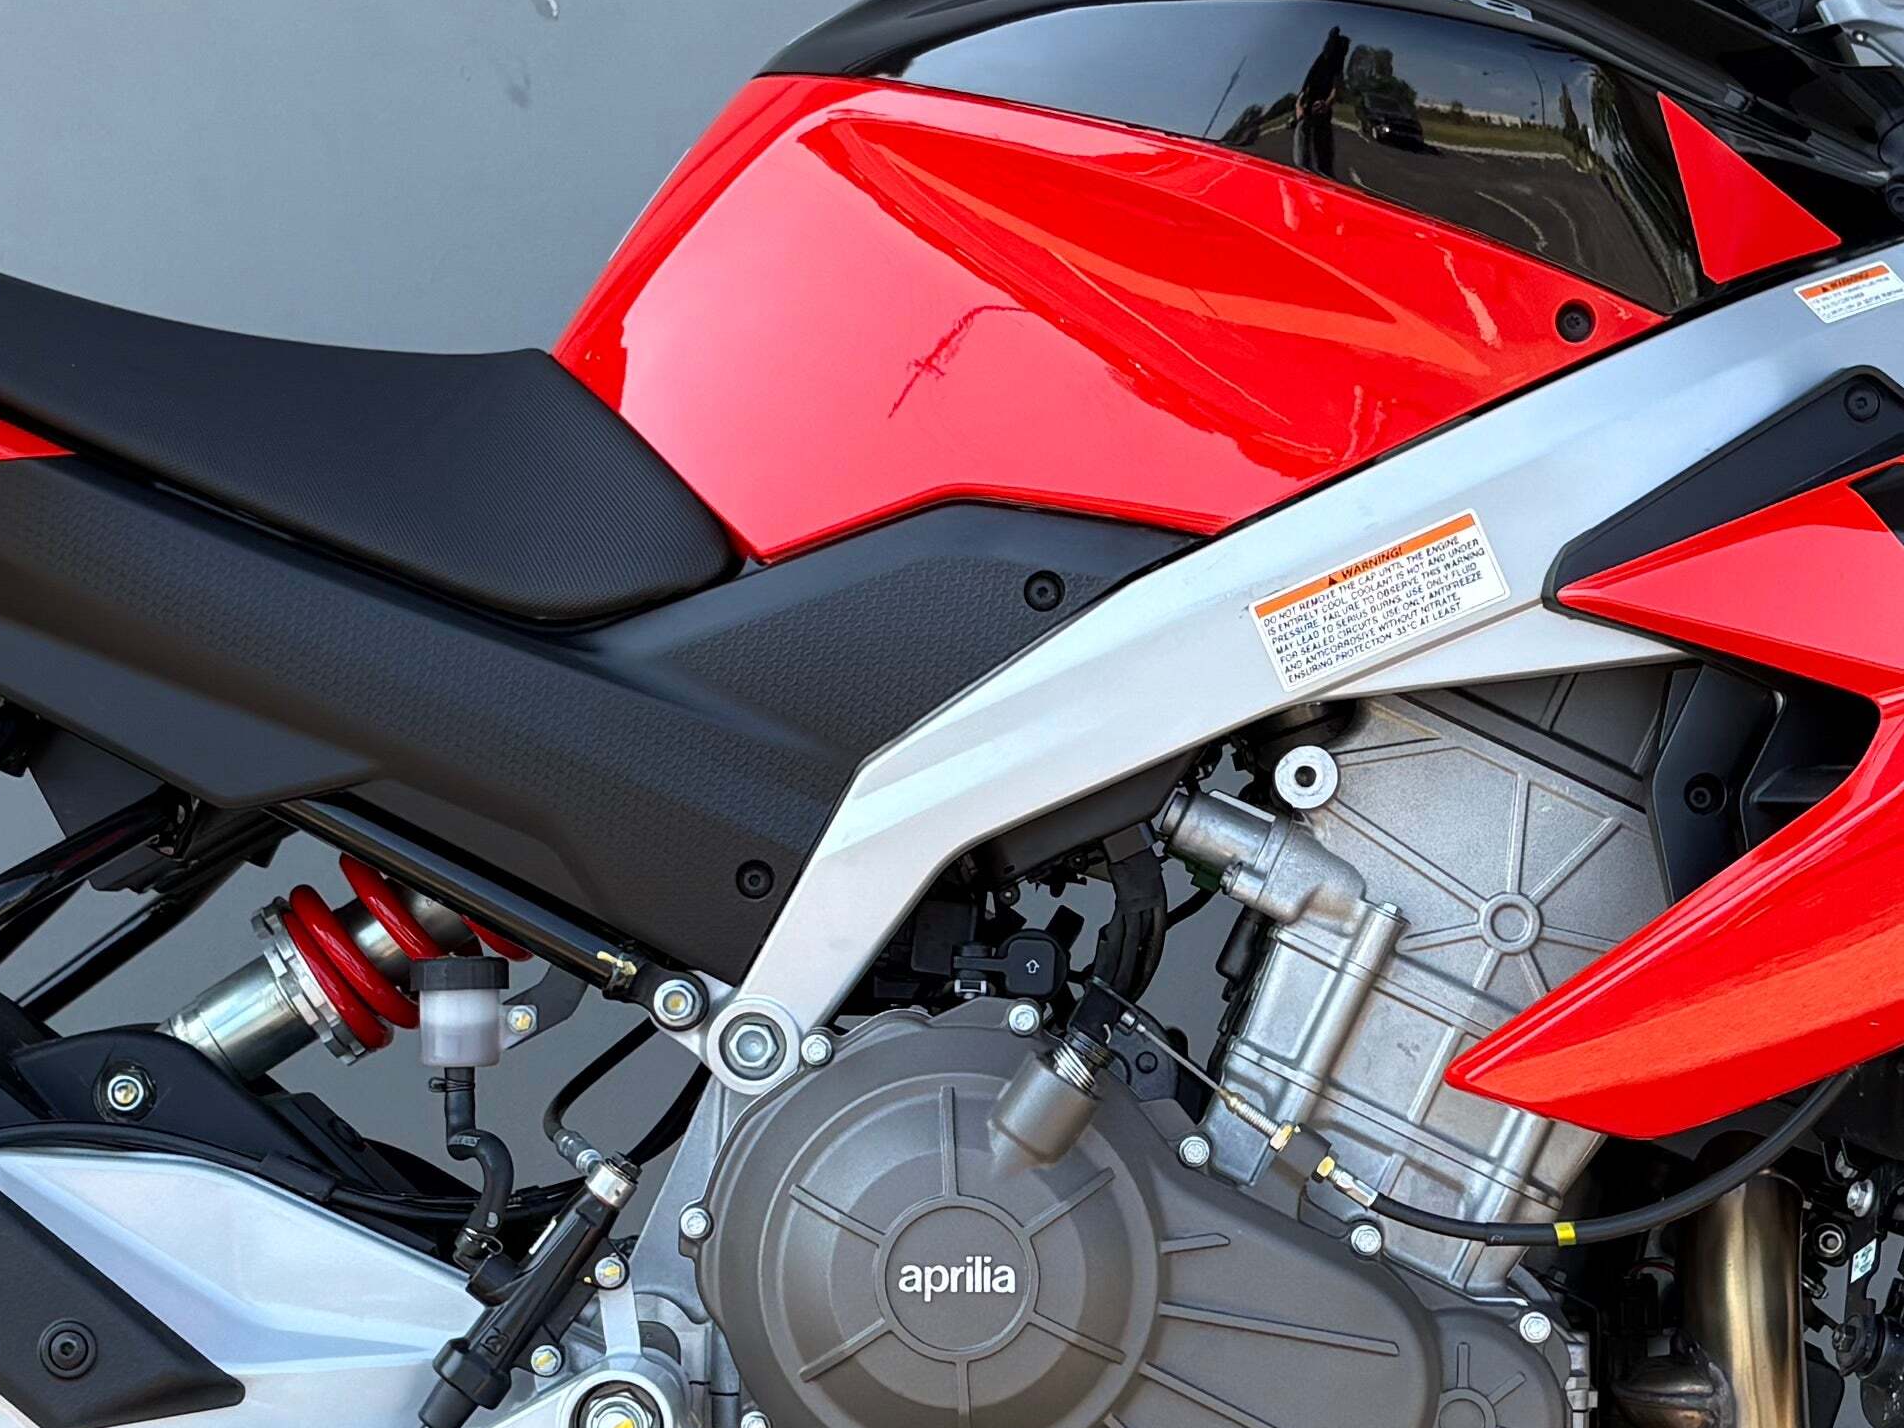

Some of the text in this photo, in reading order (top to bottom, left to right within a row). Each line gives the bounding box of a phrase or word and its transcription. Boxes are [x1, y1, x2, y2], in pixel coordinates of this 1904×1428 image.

[1262, 615, 1277, 627] DO
[1278, 606, 1296, 620] NOT
[1298, 589, 1336, 611] REMOVE
[1338, 580, 1356, 594] THE
[1406, 551, 1423, 564] THE
[1424, 535, 1459, 556] ENGINE
[1266, 626, 1276, 636] IS
[1277, 608, 1319, 632] ENTIRELY
[1349, 575, 1394, 600] COOLANT
[1395, 570, 1404, 580] IS
[1426, 552, 1446, 566] AND
[1447, 538, 1479, 557] UNDER
[1322, 601, 1360, 623] FAILURE
[1362, 594, 1375, 606] TO
[1375, 575, 1419, 600] OBSERVE
[1420, 565, 1441, 580] THIS
[1442, 546, 1485, 570] WARNING
[1340, 545, 1403, 580] WARNING!
[1275, 641, 1294, 655] MAY
[1295, 630, 1320, 646] LEAD
[1321, 623, 1334, 635] TO
[1404, 584, 1423, 598] USE
[1425, 573, 1449, 589] ONLY
[1279, 650, 1299, 665] FOR
[1381, 606, 1400, 620] USE
[1401, 594, 1426, 611] ONLY
[1417, 615, 1430, 626] AT
[1283, 659, 1303, 674] AND
[896, 1255, 1017, 1303] aprilia
